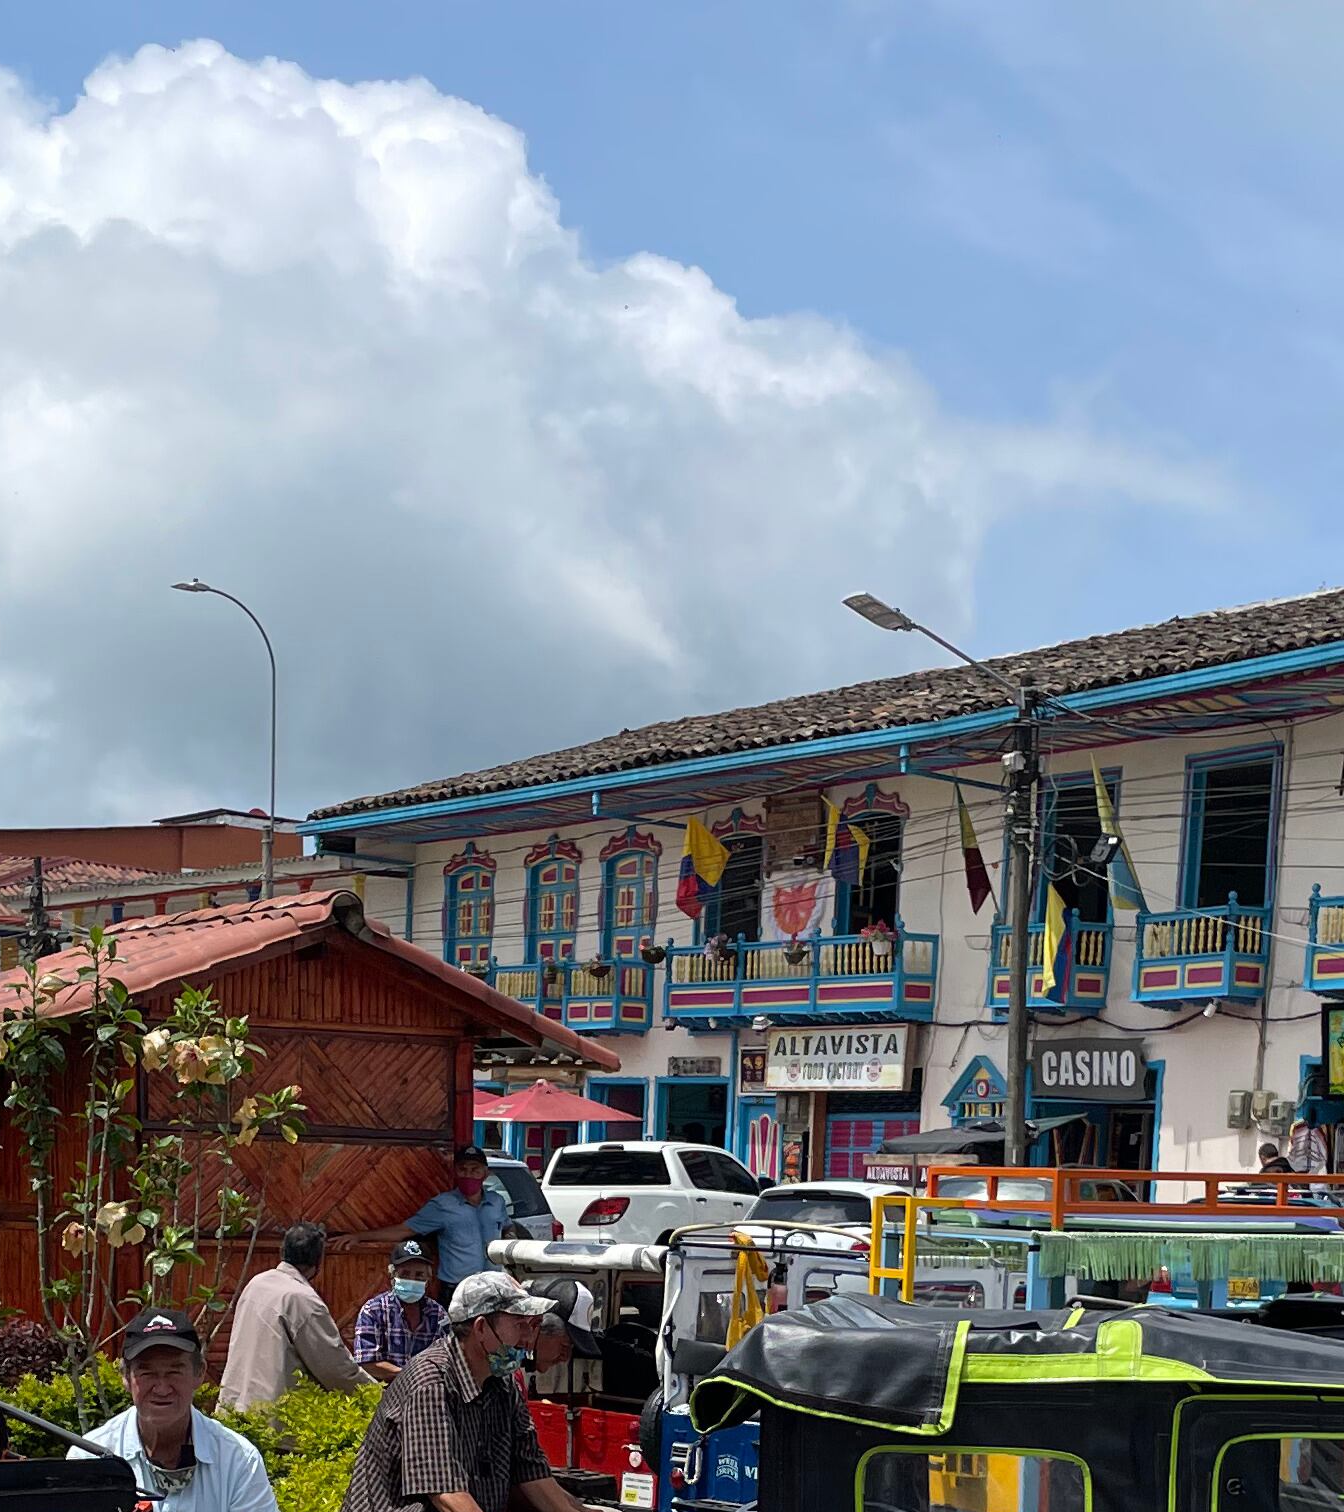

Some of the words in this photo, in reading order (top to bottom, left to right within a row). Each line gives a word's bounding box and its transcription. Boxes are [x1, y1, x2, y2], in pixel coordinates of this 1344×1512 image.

[774, 1033, 899, 1057] ALTAVISTA
[802, 1063, 824, 1081] FOOD
[1042, 1050, 1136, 1087] CASINO
[866, 1166, 910, 1181] ALTAVISTA
